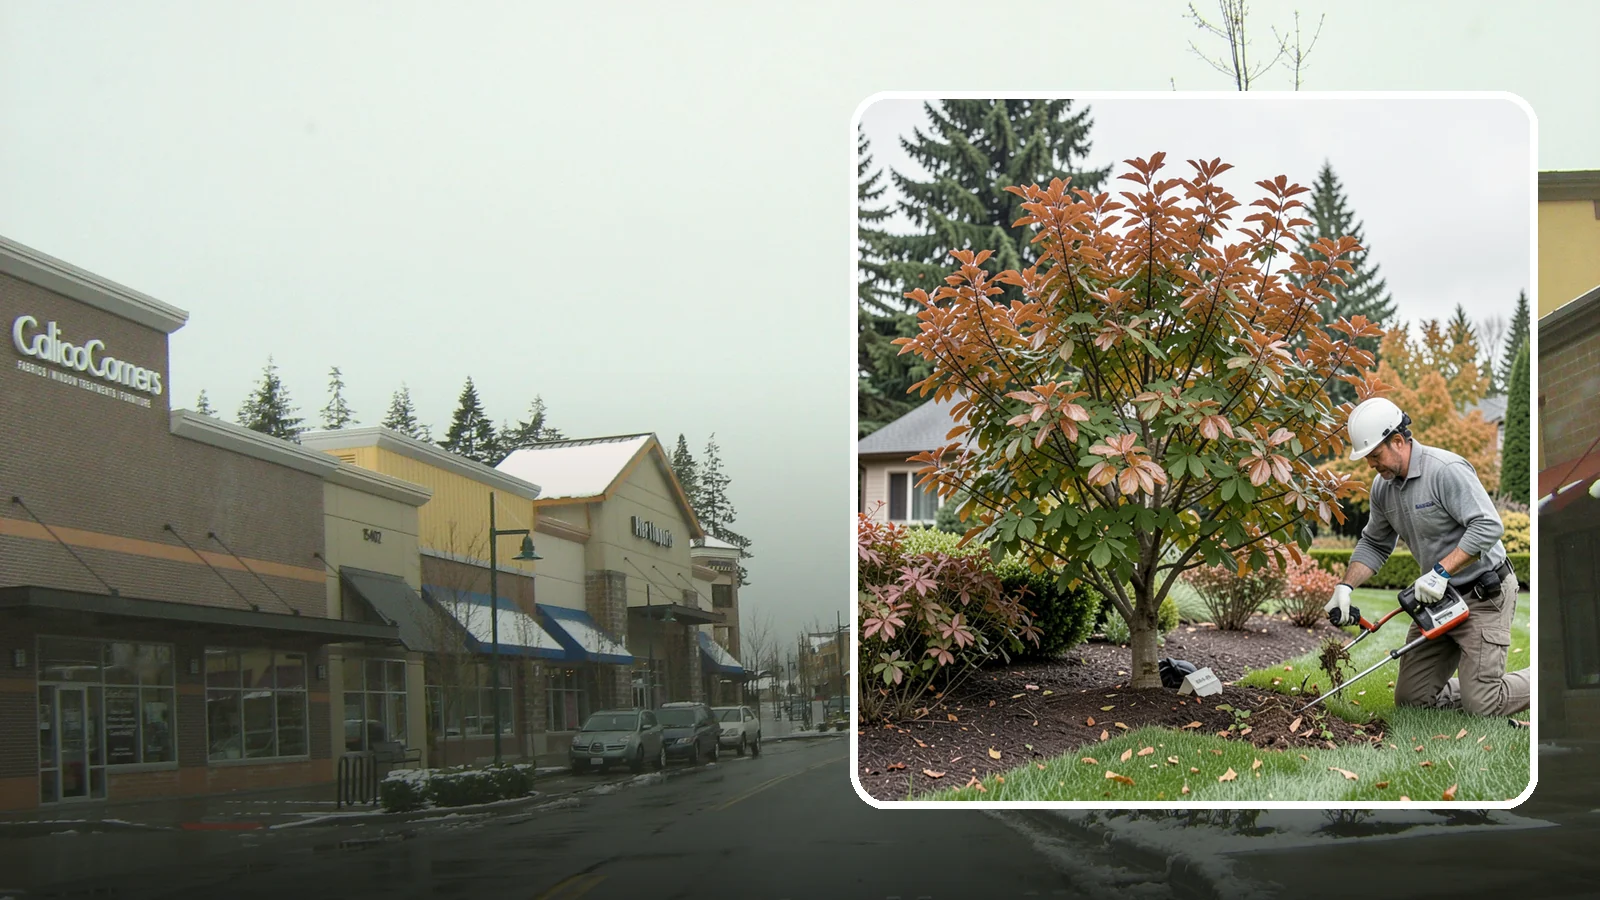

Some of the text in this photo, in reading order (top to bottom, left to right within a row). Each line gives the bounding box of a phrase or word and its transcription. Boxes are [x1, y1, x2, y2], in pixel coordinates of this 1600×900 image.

[12, 315, 162, 395] CalicoCorners
[17, 360, 151, 408] FABRICS WINDOW TREATMENTS FURNITURE
